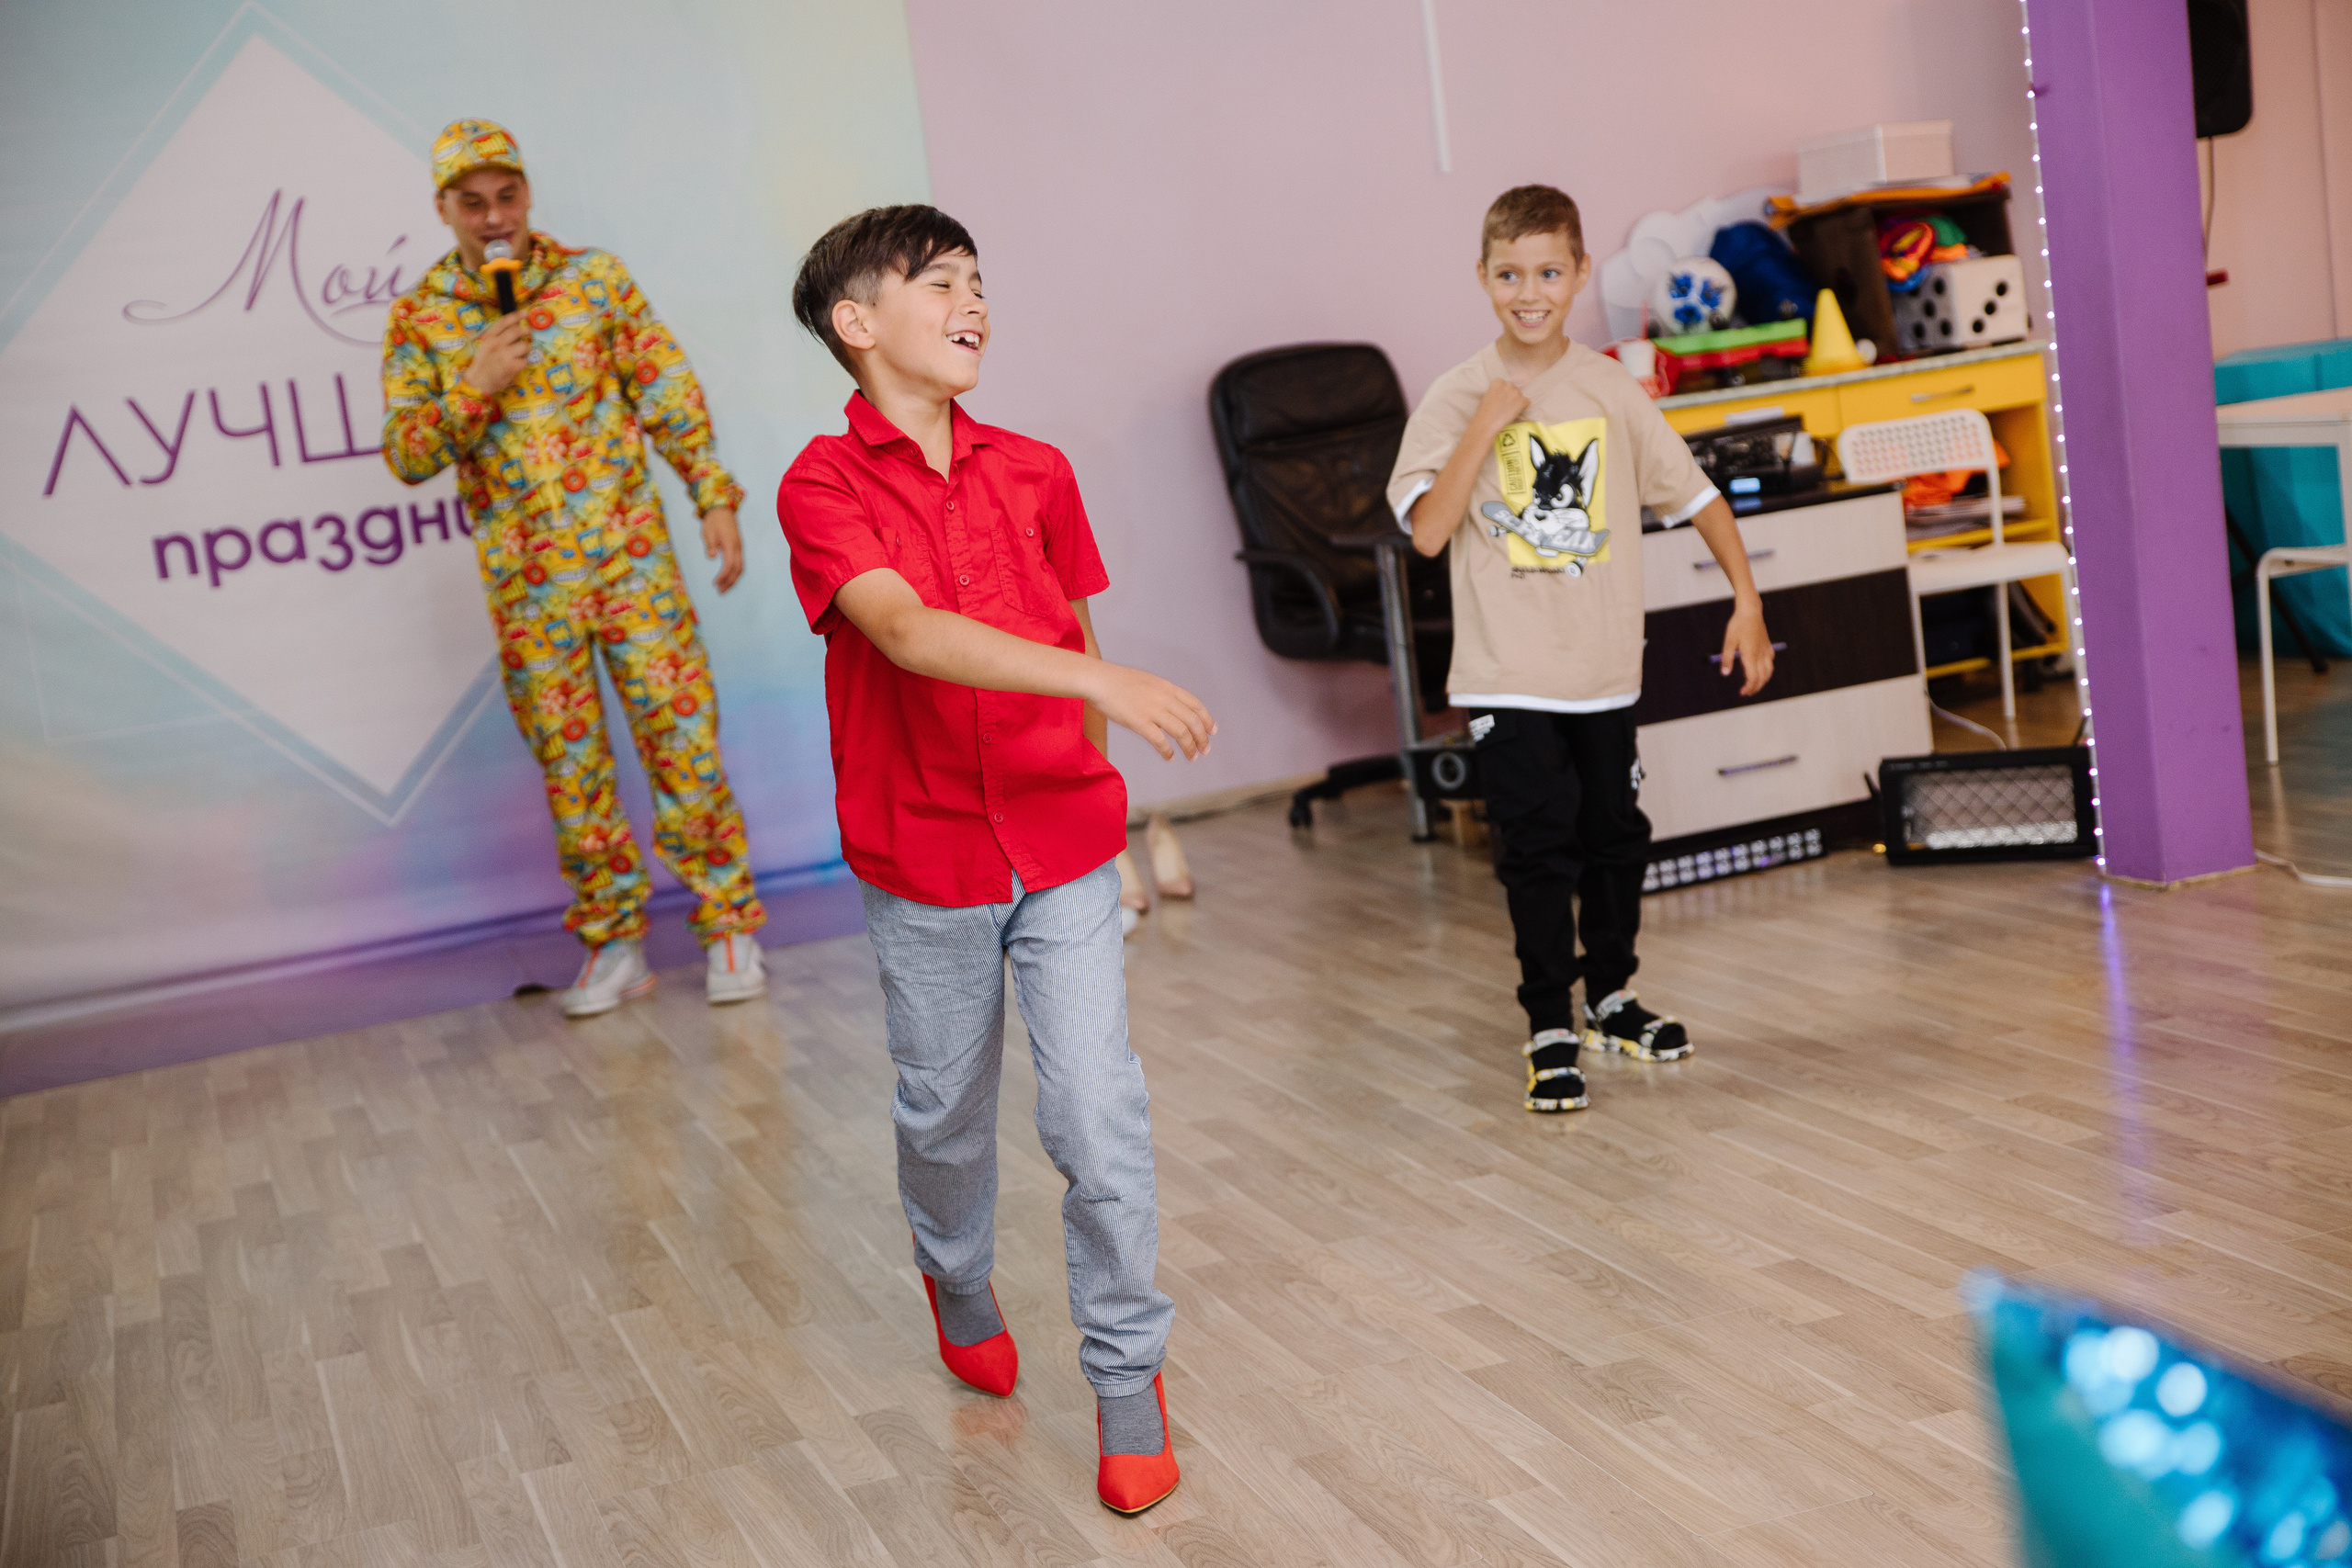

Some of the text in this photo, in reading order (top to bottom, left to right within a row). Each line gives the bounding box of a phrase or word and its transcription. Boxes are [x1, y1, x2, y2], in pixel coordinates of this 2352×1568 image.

[121, 187, 415, 347] Мой
[42, 373, 382, 497] ЛУЧШ
[151, 495, 473, 589] праздн
